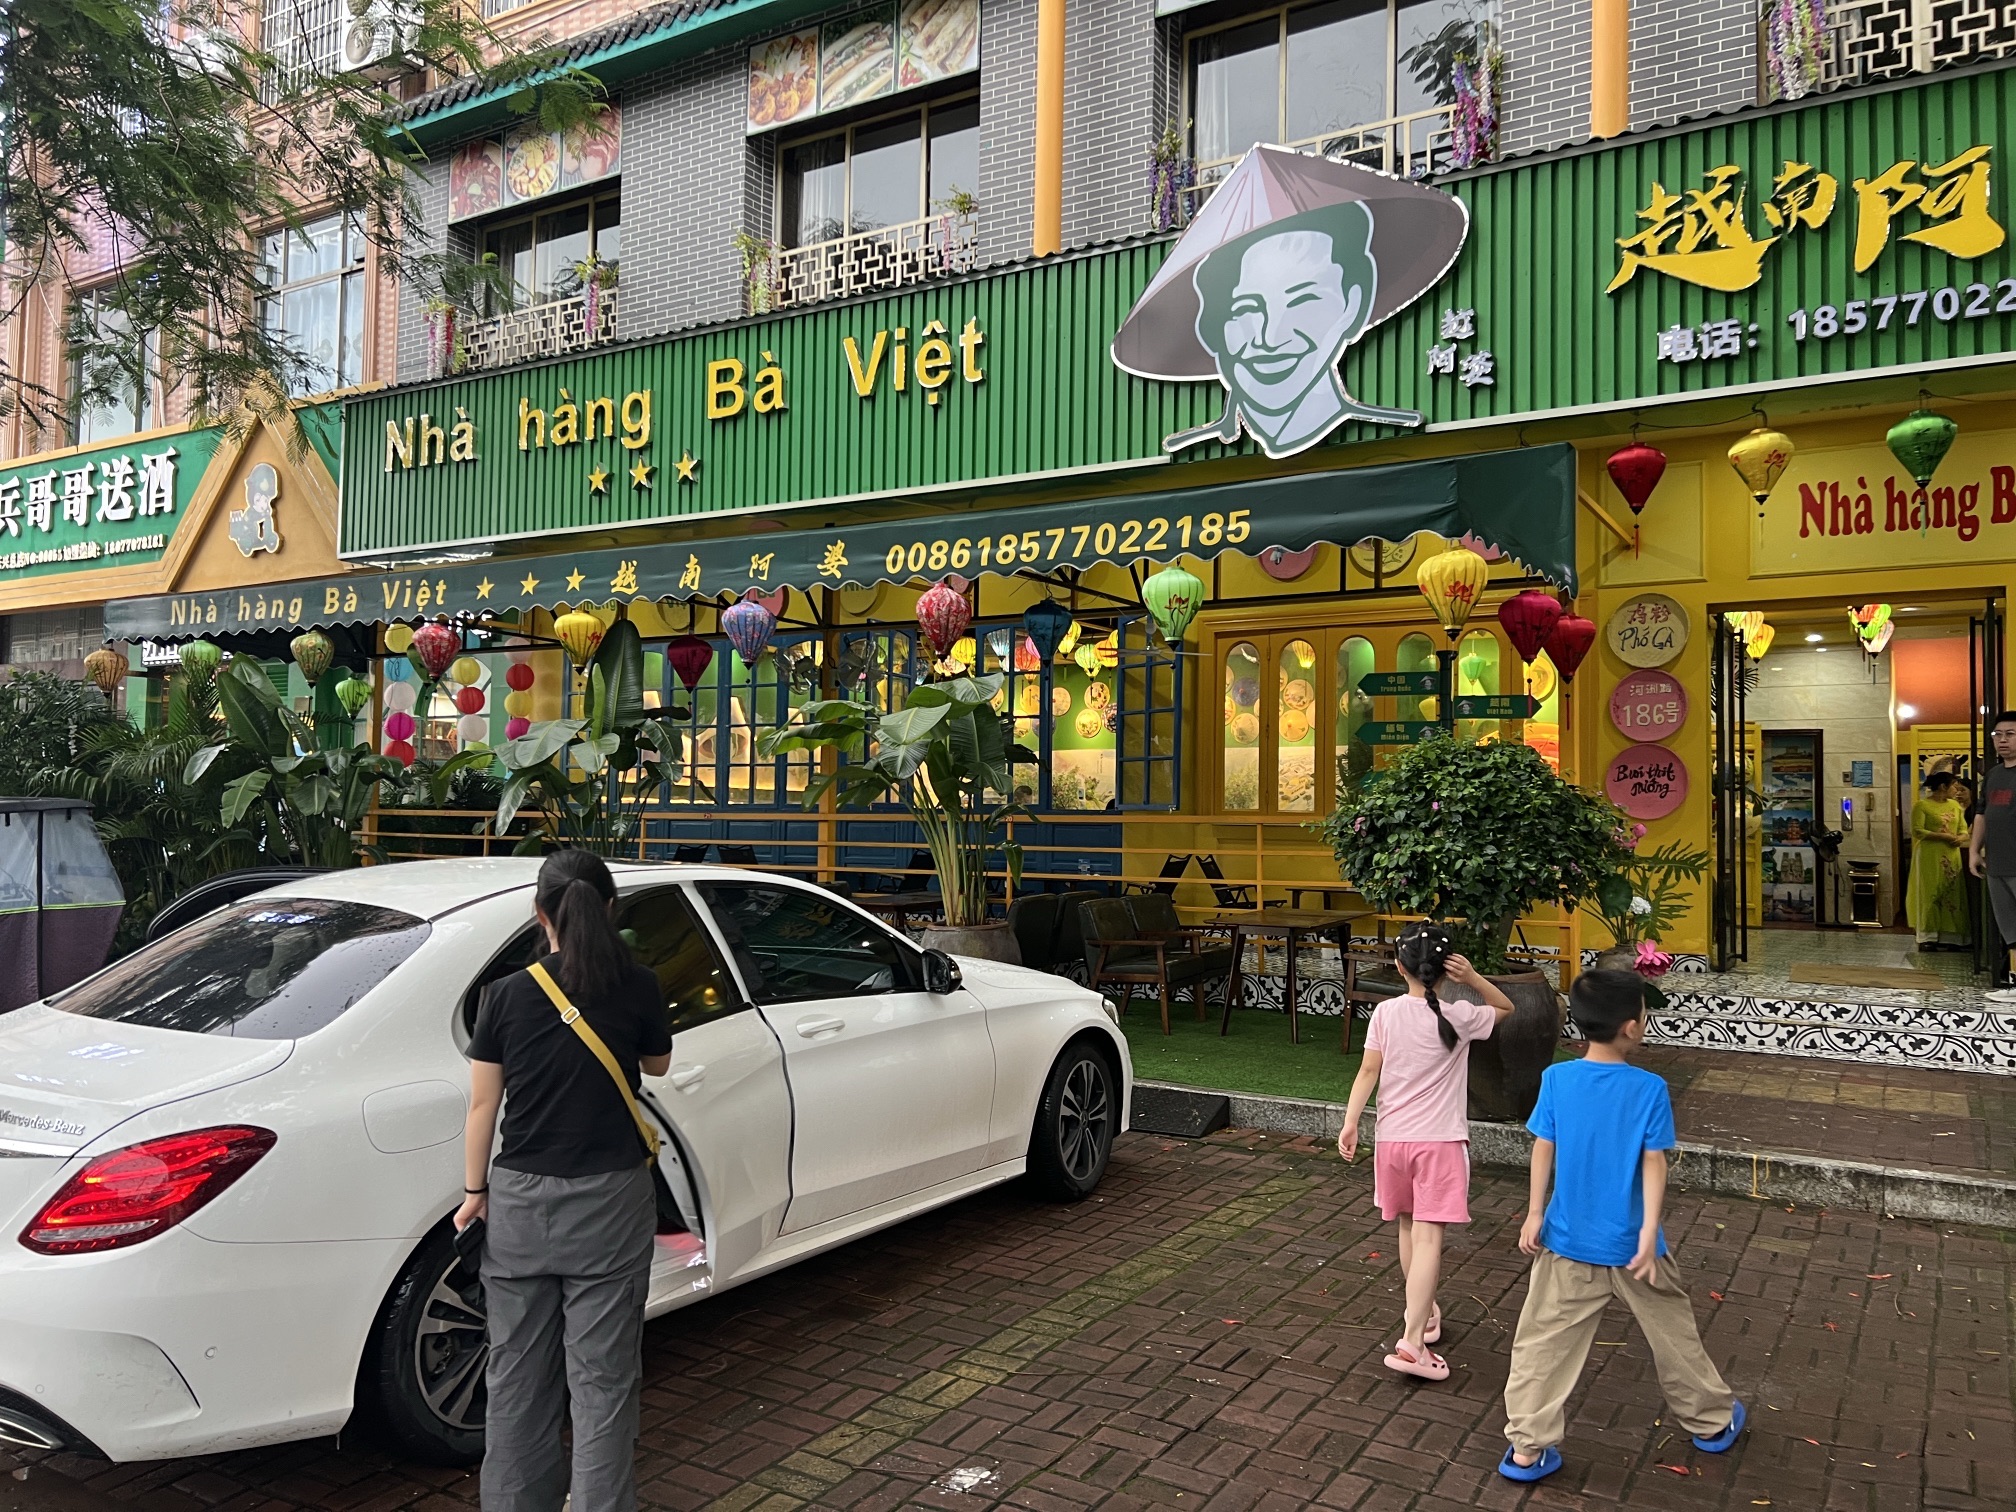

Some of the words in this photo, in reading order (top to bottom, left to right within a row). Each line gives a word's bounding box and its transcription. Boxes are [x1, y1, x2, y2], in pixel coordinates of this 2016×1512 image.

[1604, 144, 2006, 293] 越南阿
[385, 406, 475, 473] Nhà
[518, 387, 653, 451] hàng
[707, 350, 788, 420] Bà
[843, 316, 985, 405] Việt
[1798, 476, 1875, 539] Nhà
[885, 509, 1251, 575] 008618577022185
[170, 598, 218, 626] Nhà
[237, 593, 303, 624] hàng
[323, 586, 358, 615] Bà
[381, 579, 447, 613] Việt
[1623, 701, 1680, 727] 186号
[0, 1109, 85, 1136] Mercedes-Benz
